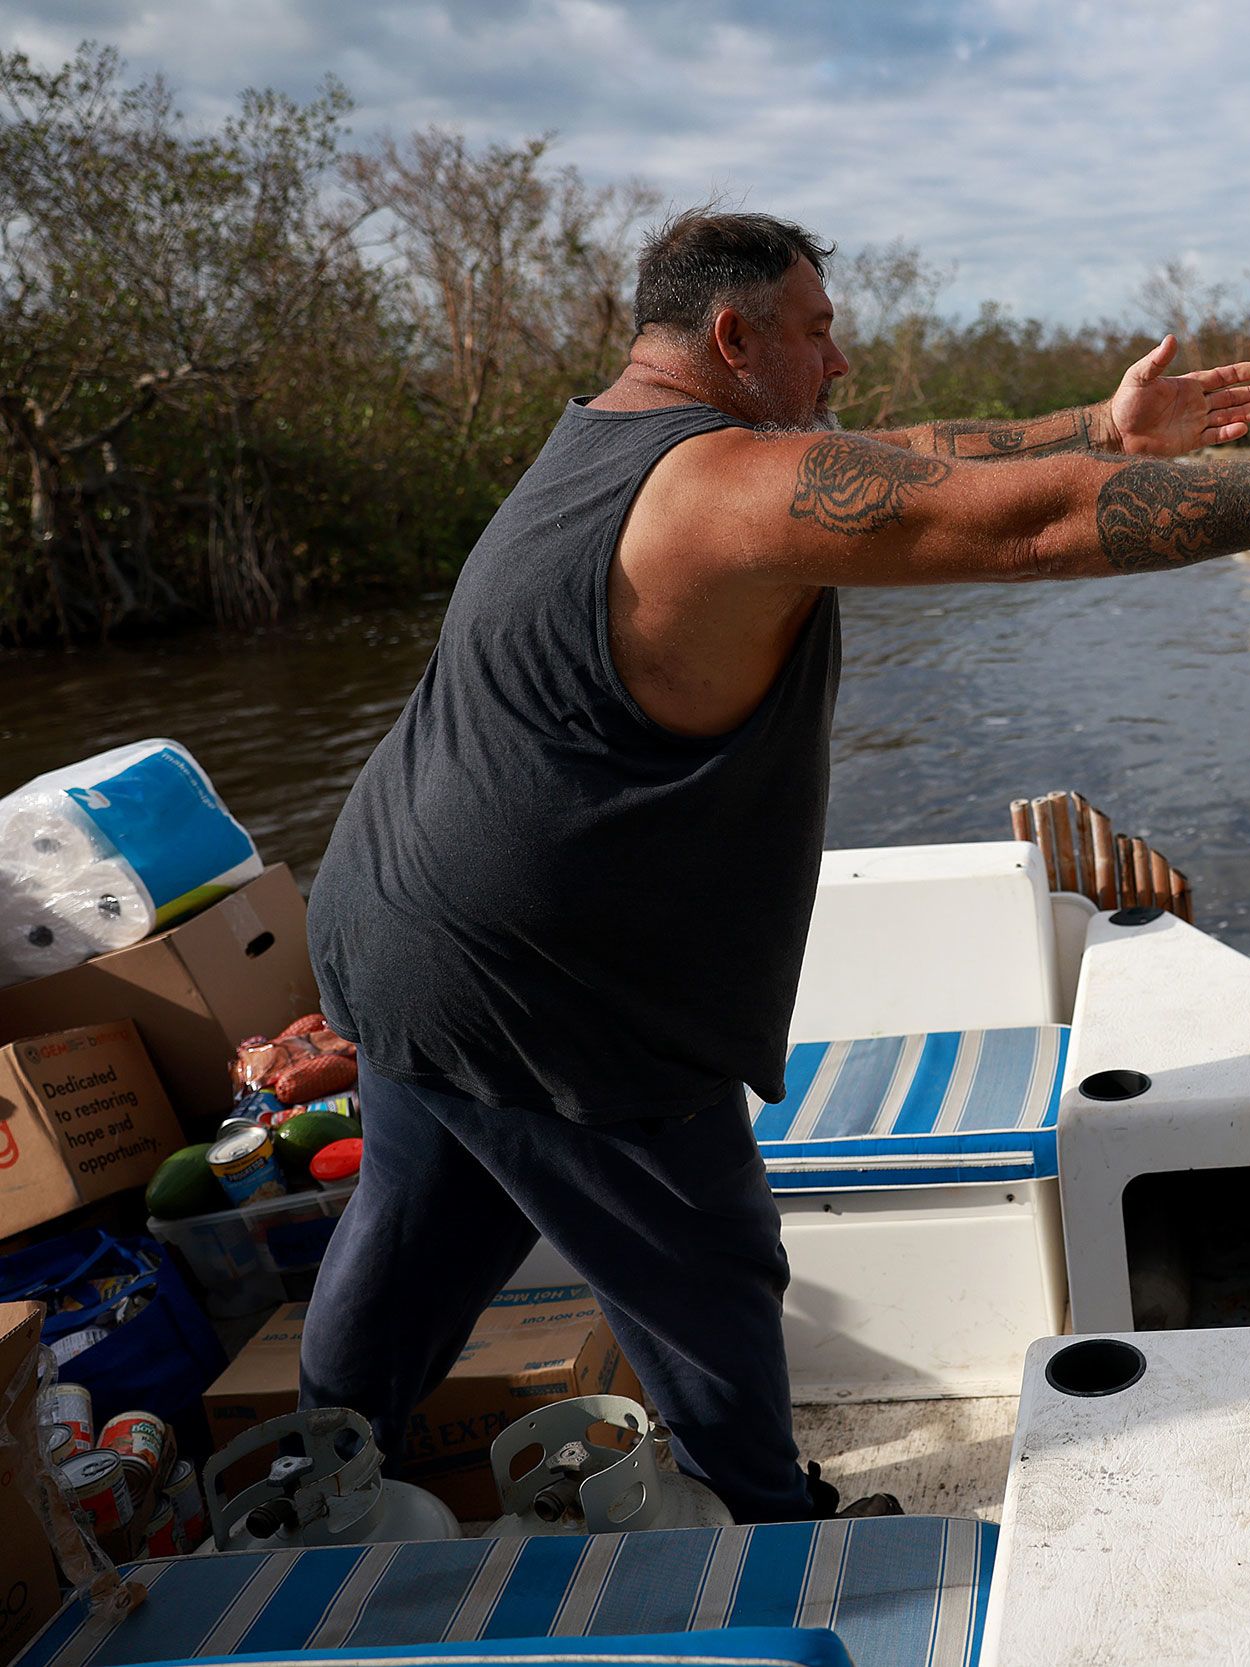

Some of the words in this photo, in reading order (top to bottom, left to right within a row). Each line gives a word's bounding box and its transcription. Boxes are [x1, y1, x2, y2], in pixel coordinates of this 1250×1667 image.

[43, 1065, 118, 1099] Dedicated
[55, 1109, 72, 1124] to
[75, 1091, 138, 1118] restoring
[64, 1127, 105, 1149] hope
[108, 1113, 134, 1136] and
[79, 1136, 161, 1175] opportunity.
[522, 1316, 545, 1324] CUT
[547, 1312, 573, 1320] NOT
[575, 1309, 595, 1318] DO
